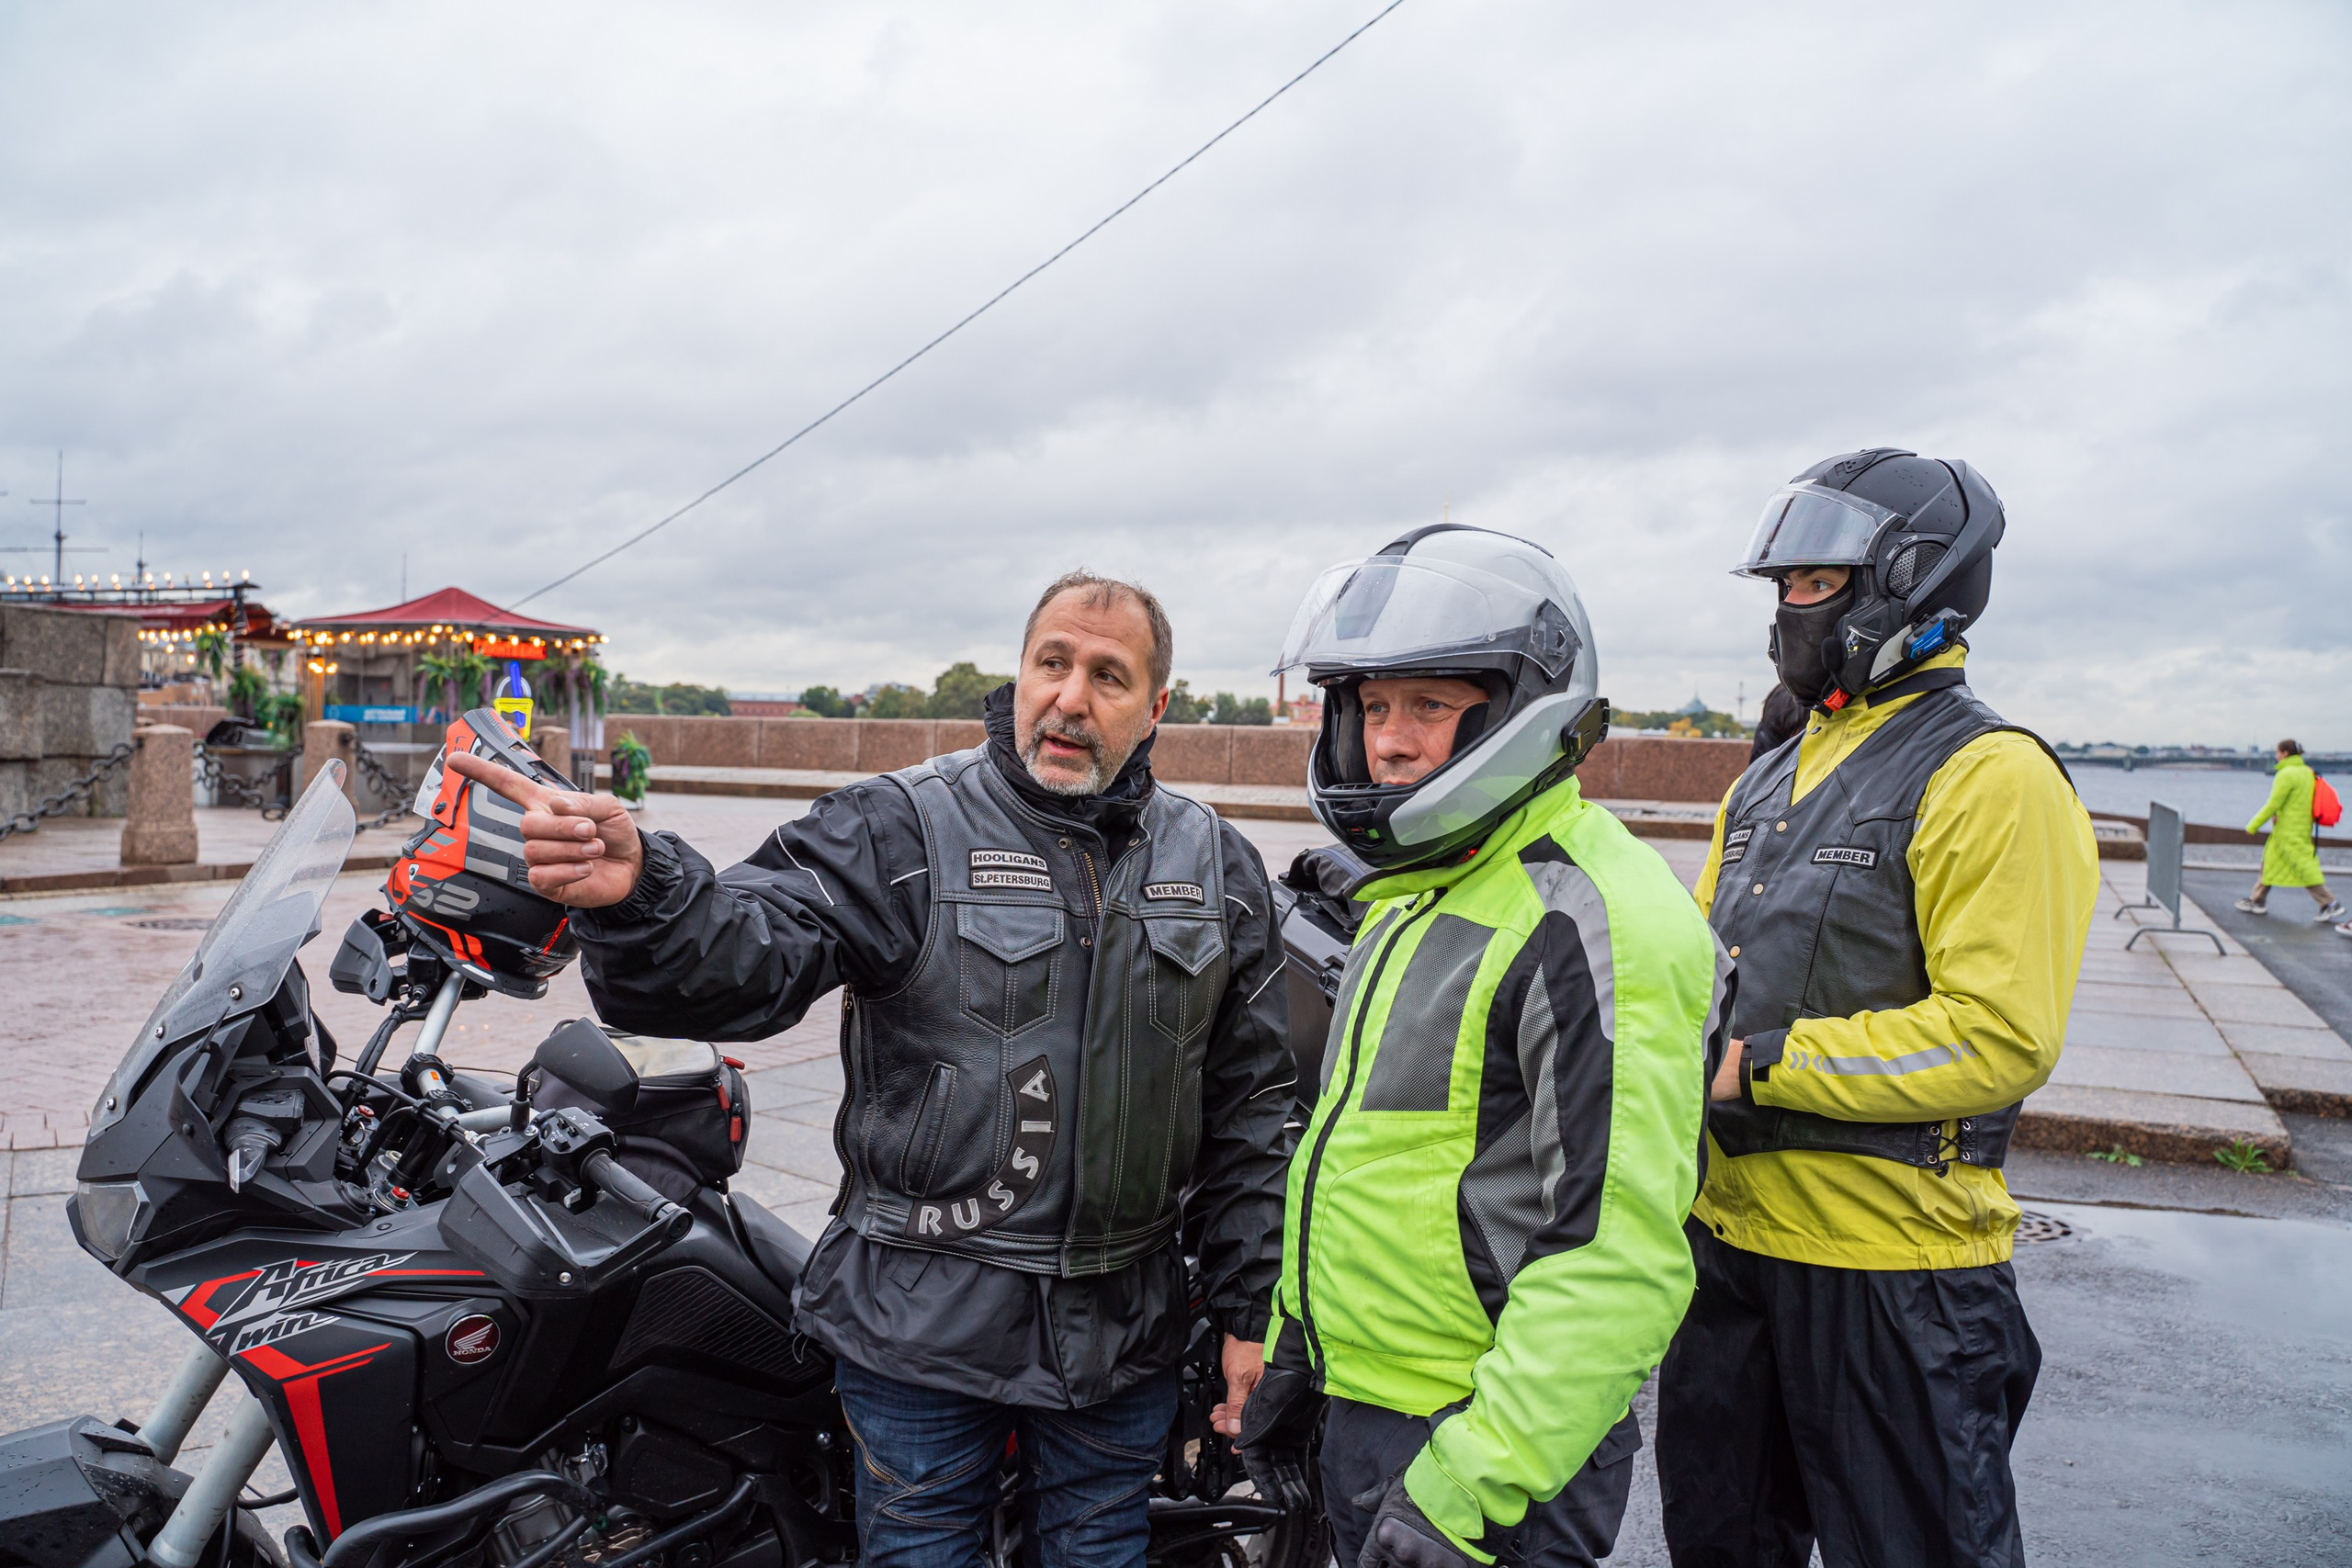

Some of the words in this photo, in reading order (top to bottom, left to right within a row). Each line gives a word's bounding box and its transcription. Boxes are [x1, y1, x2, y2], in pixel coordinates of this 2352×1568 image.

[974, 853, 1046, 868] HOOLIGANS
[1817, 850, 1871, 863] MEMBER
[1149, 886, 1202, 898] MEMBER
[919, 1069, 1050, 1237] RUSSIA
[209, 1250, 419, 1327] Africa
[206, 1311, 342, 1356] Twin
[453, 1347, 492, 1356] HONDA
